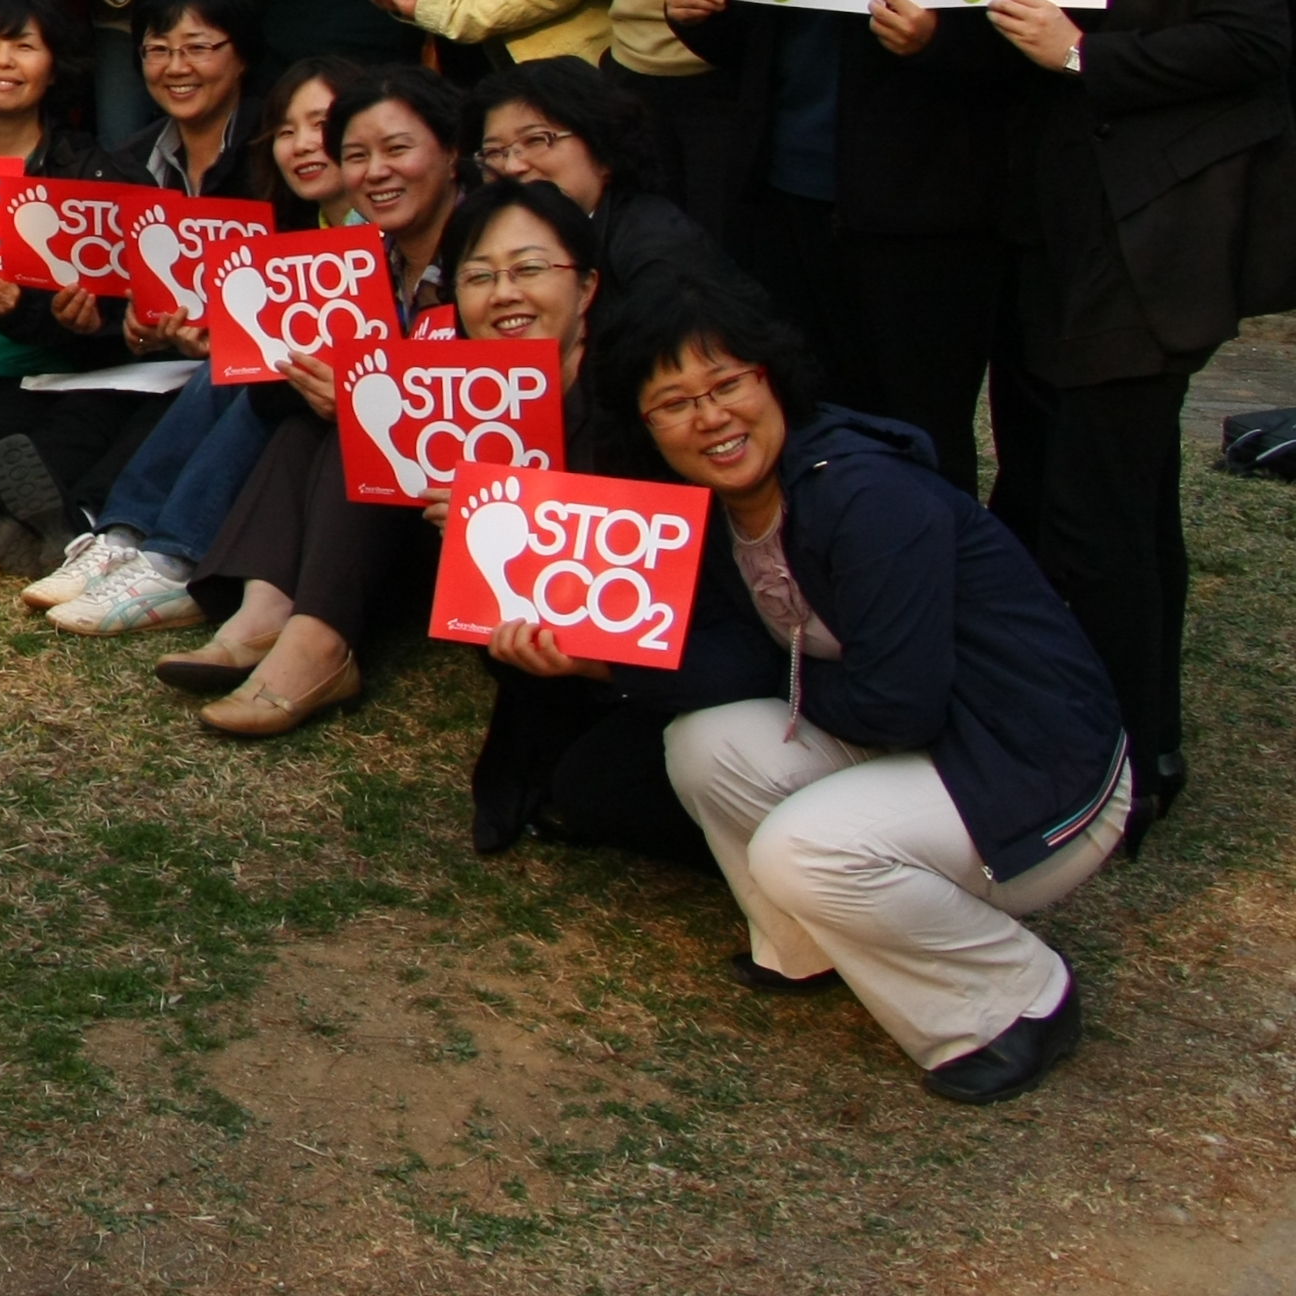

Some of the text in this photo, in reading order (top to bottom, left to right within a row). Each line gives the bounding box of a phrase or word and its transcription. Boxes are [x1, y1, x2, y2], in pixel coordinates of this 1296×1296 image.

[267, 249, 376, 303] STOP
[401, 366, 547, 421] STOP
[527, 500, 690, 569] STOP
